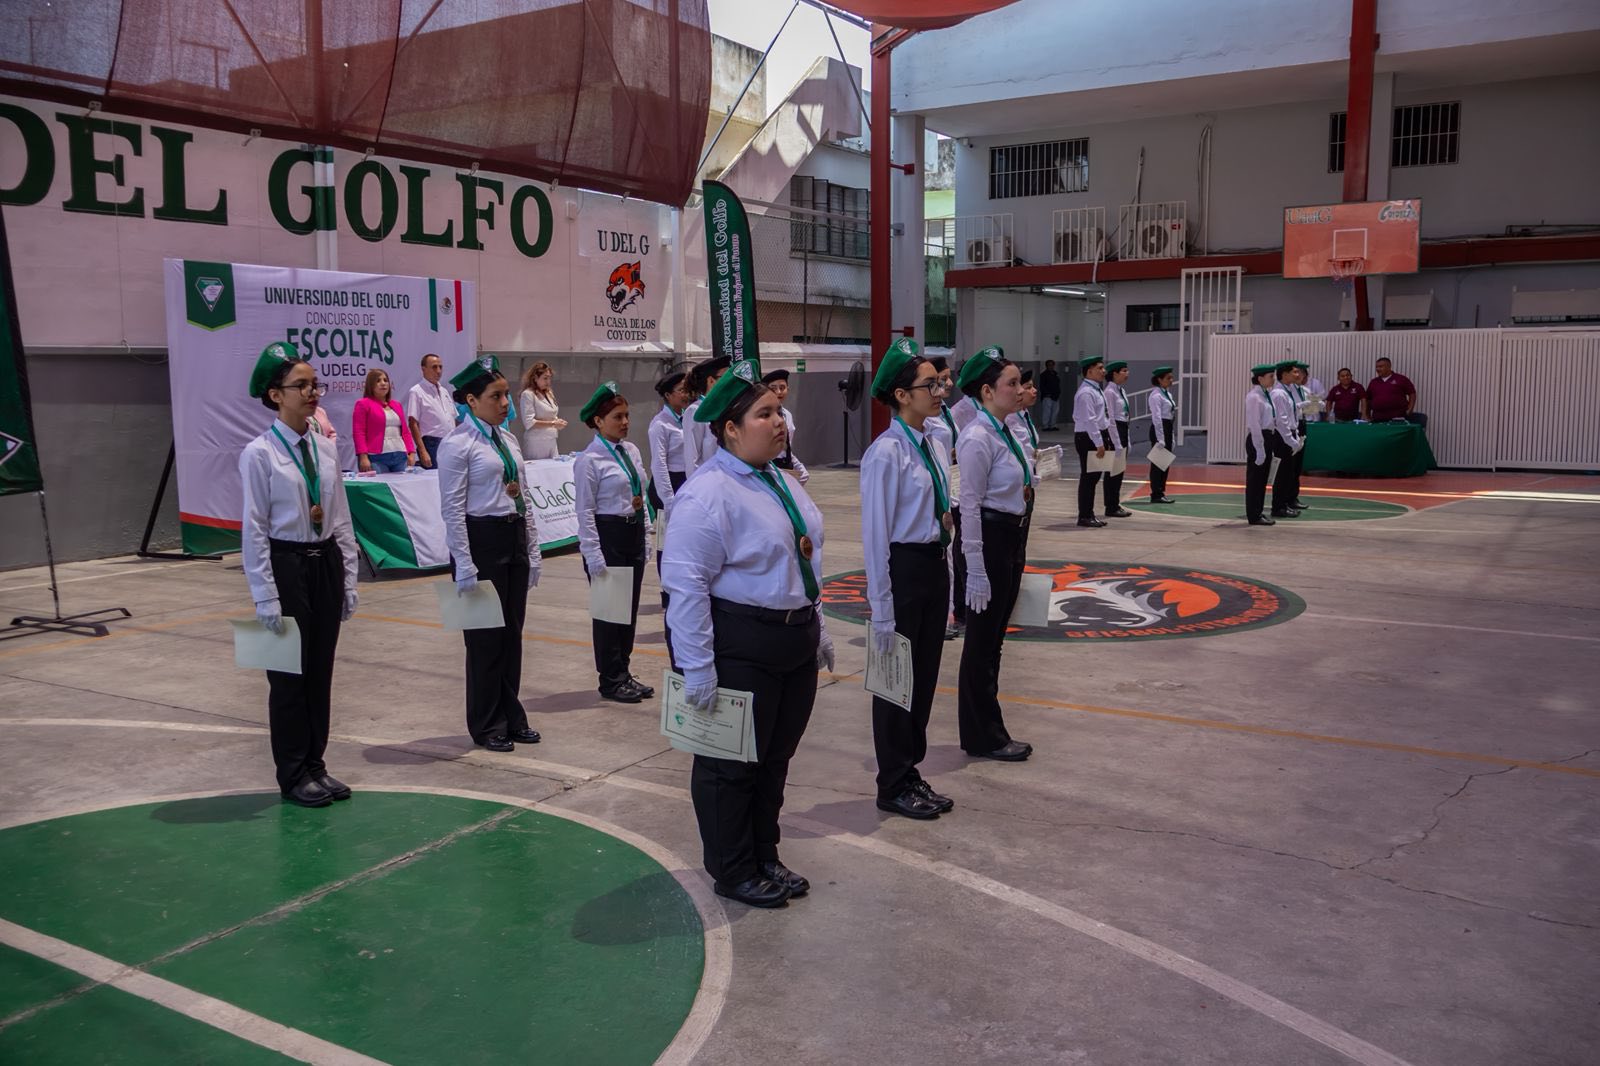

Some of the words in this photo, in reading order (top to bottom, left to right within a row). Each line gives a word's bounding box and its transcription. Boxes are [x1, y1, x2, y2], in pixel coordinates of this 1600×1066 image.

[0, 103, 228, 226] DEL
[267, 148, 554, 258] GOLFO
[712, 198, 728, 247] Golfo
[597, 230, 608, 251] U
[611, 231, 637, 254] DEL
[639, 234, 650, 255] G
[715, 249, 729, 275] del
[264, 287, 349, 307] UNIVERSIDAD
[352, 291, 374, 308] DEL
[376, 293, 410, 309] GOLFO
[306, 312, 360, 326] CONCURSO
[363, 314, 375, 326] DE
[594, 315, 605, 327] LA
[606, 317, 628, 328] CASA
[630, 318, 641, 329] DE
[641, 319, 656, 329] LOS
[607, 330, 647, 340] COYOTES
[287, 328, 394, 365] ESCOLTAS
[321, 363, 367, 377] UDELG
[332, 381, 395, 393] PREPARA
